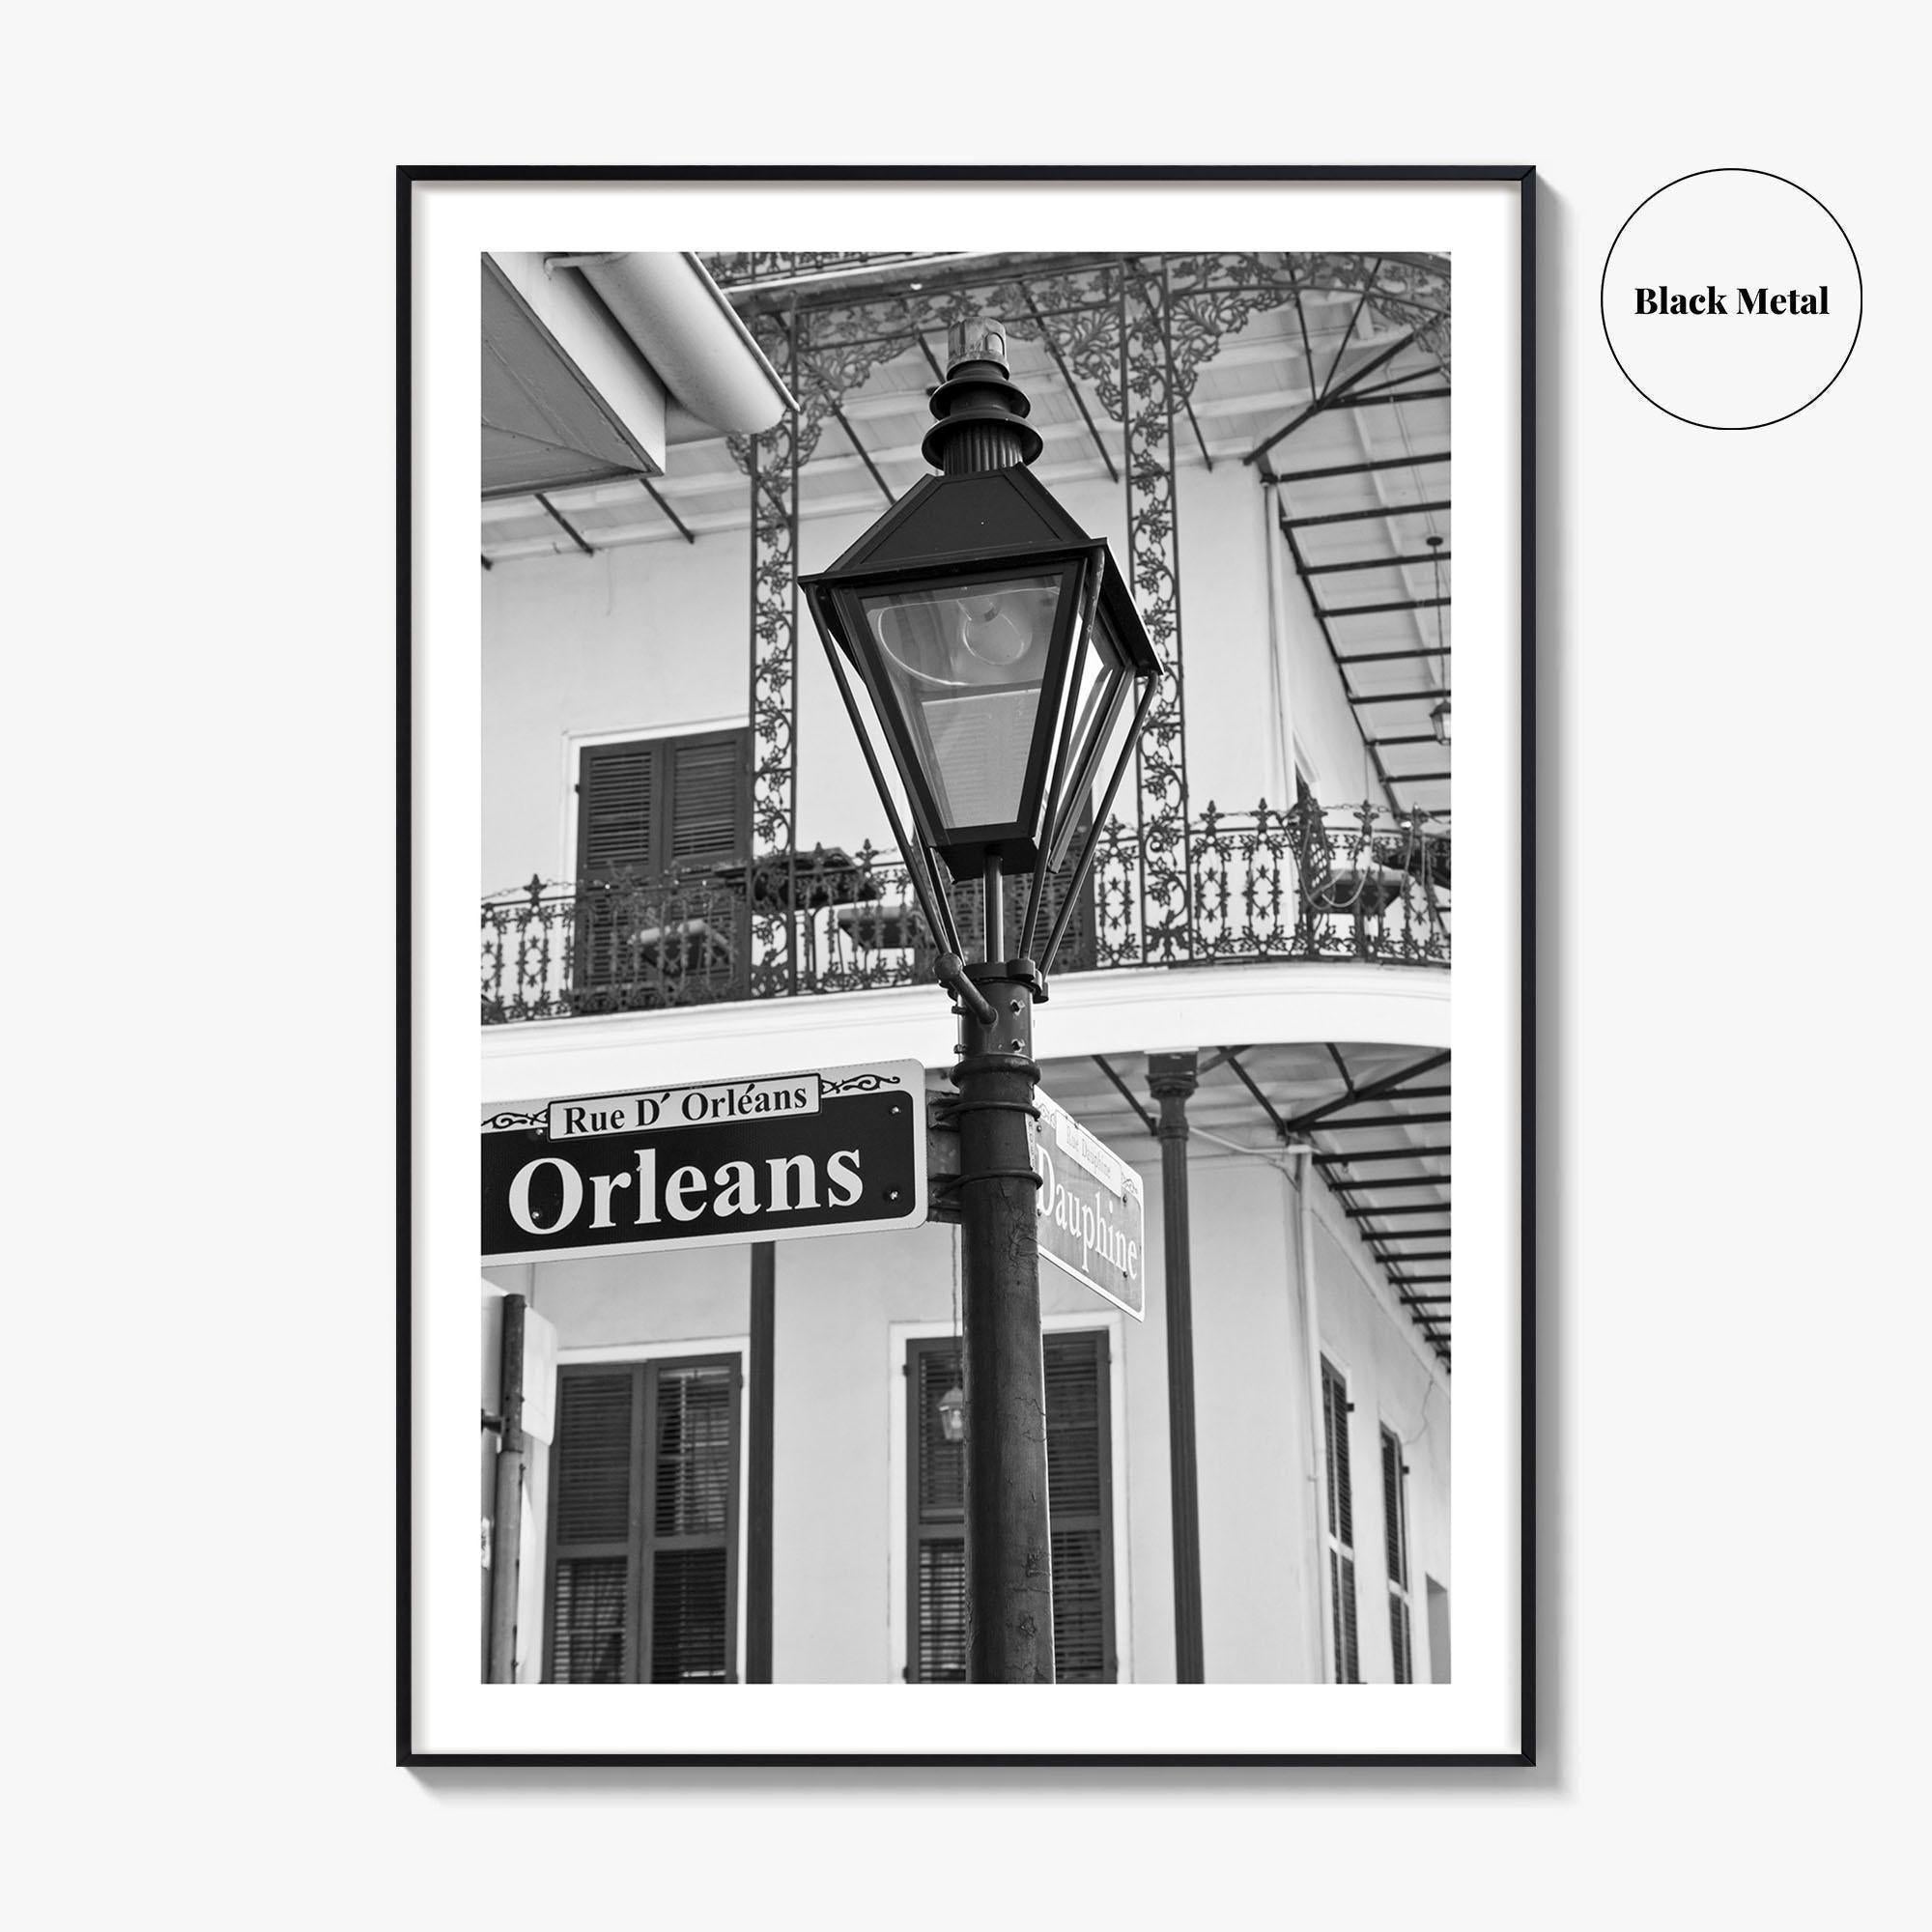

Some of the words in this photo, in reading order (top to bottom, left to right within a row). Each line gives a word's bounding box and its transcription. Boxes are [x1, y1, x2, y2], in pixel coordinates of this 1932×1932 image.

[563, 1106, 625, 1134] Rue
[682, 1083, 808, 1121] Orléans
[508, 1148, 864, 1235] Orleans
[1037, 1143, 1138, 1280] Dauphine
